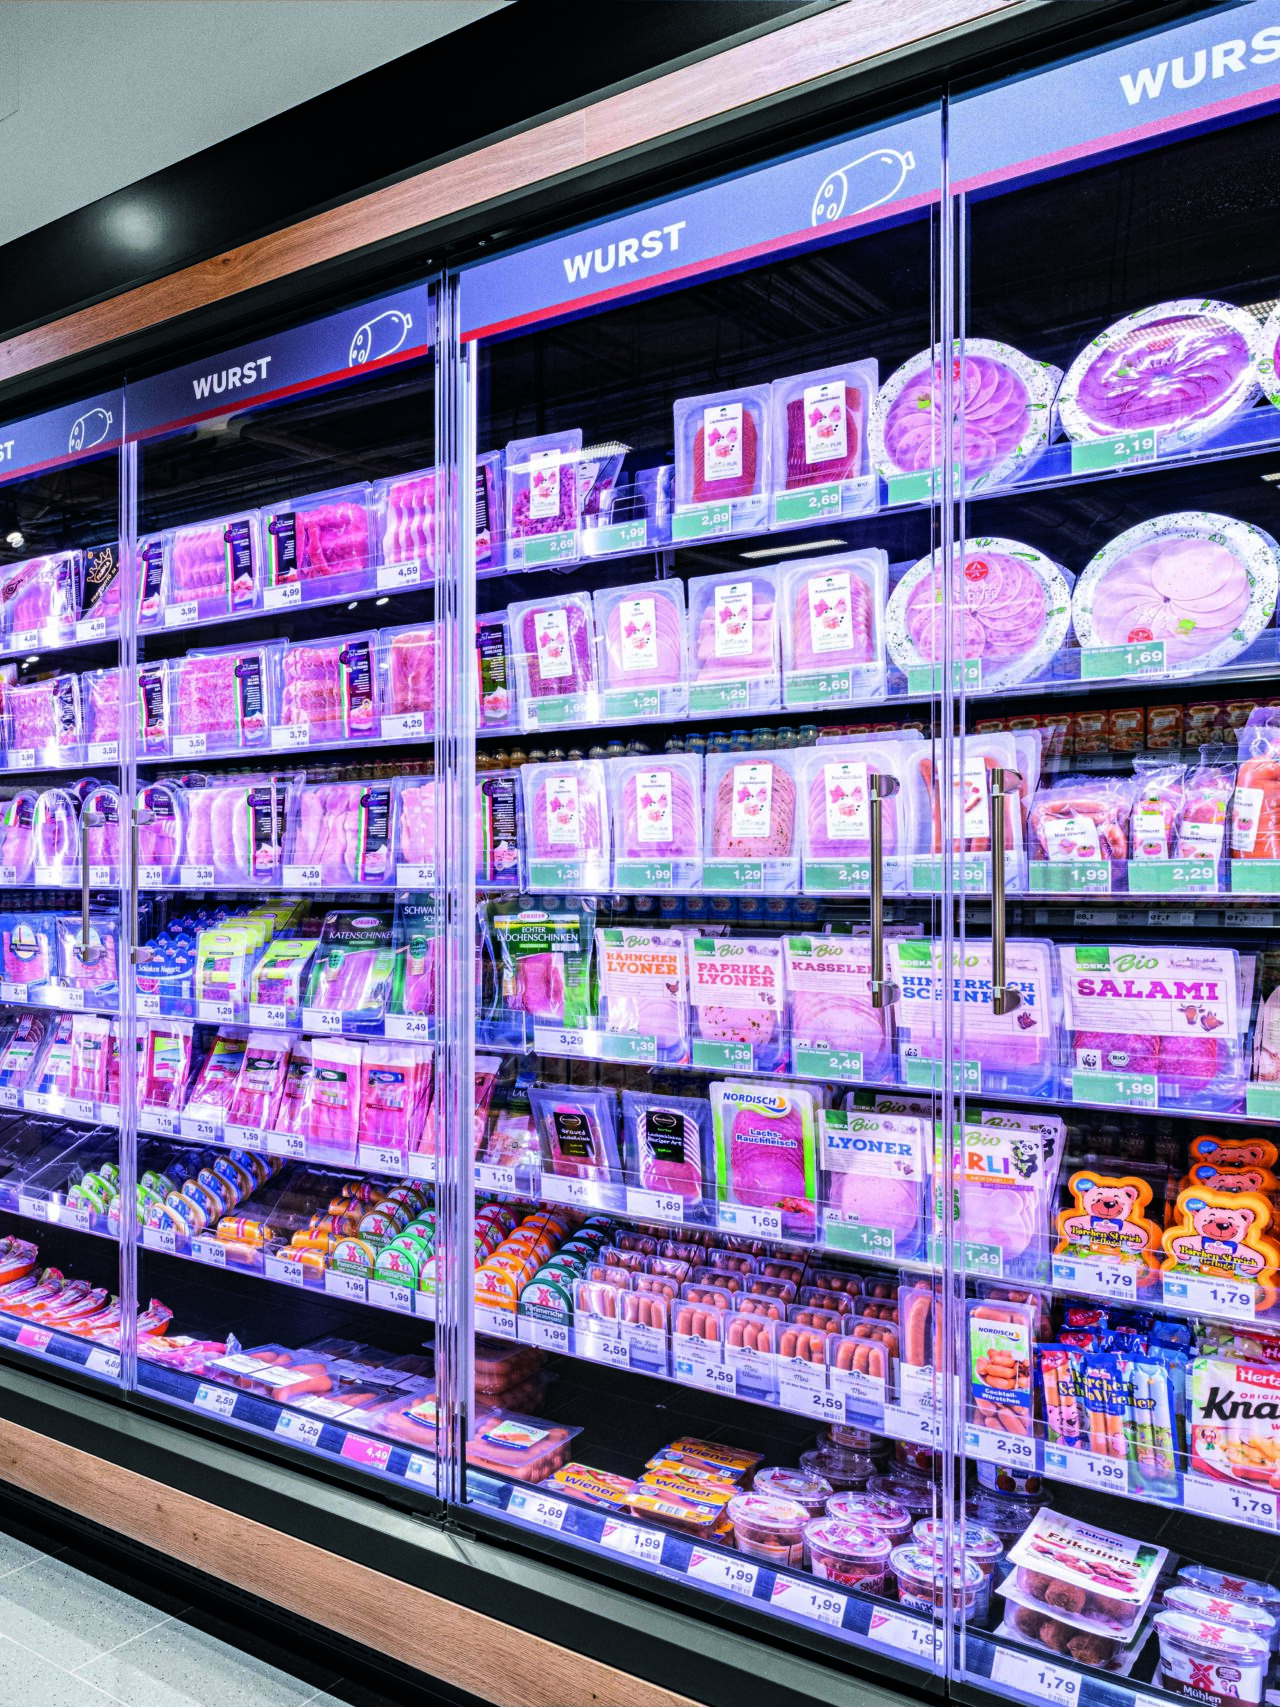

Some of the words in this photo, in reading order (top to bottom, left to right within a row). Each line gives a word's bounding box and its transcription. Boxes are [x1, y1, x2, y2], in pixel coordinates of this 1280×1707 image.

[1119, 26, 1280, 106] WURS
[563, 222, 687, 283] WURST
[192, 356, 273, 400] WURST
[1114, 438, 1153, 455] 2,19
[809, 494, 839, 508] 2,69
[702, 512, 729, 526] 2,89
[620, 526, 644, 539] 1,99
[550, 539, 574, 551] 2,69
[398, 565, 418, 577] 4,59
[282, 588, 299, 598] 4,99
[180, 606, 197, 617] 3,99
[90, 622, 105, 631] 4,99
[1124, 651, 1163, 665] 1,69
[819, 680, 849, 692] 2,69
[719, 689, 746, 701] 1,29
[633, 697, 657, 708] 1,29
[402, 719, 422, 730] 4,29
[289, 729, 307, 740] 3,79
[189, 739, 205, 748] 3,59
[146, 871, 161, 880] 2,19
[197, 870, 213, 879] 3,39
[301, 870, 320, 880] 4,59
[556, 869, 580, 880] 1,29
[645, 869, 670, 880] 1,99
[734, 870, 761, 881] 1,29
[839, 870, 870, 881] 2,49
[1072, 869, 1108, 882] 1,99
[1172, 868, 1213, 881] 2,29
[521, 926, 546, 934] ECHTER
[625, 935, 650, 948] Bio
[606, 951, 677, 963] HÄHNCHEN
[717, 944, 744, 957] Bio
[813, 944, 843, 957] Bio
[137, 964, 160, 973] Schinken
[608, 962, 678, 975] LYONER
[697, 962, 775, 976] PAPRIKA
[899, 959, 932, 967] EDEKA
[1076, 962, 1111, 970] EDEKA
[1113, 953, 1159, 972] Bio
[697, 973, 775, 987] LYONER
[902, 976, 1035, 993] HINERKCH
[1077, 978, 1219, 1001] SALAMI
[144, 1000, 159, 1009] 2,39
[216, 1007, 233, 1016] 1,29
[267, 1010, 285, 1020] 2,49
[322, 1015, 340, 1024] 2,19
[406, 1022, 427, 1032] 2,49
[560, 1035, 584, 1046] 3,29
[629, 1041, 655, 1051] 1,39
[724, 1049, 751, 1060] 1,39
[829, 1058, 860, 1070] 2,49
[1115, 1081, 1154, 1095] 1,99
[723, 1092, 777, 1106] NORDISCH
[877, 1100, 907, 1114] Bio
[157, 1117, 172, 1127] 1,19
[849, 1117, 880, 1132] Bio
[197, 1124, 213, 1134] 2,19
[749, 1128, 782, 1139] Lachs-
[242, 1131, 259, 1142] 1,59
[736, 1134, 797, 1148] Rauchfleisch
[965, 1131, 1001, 1146] Bio
[286, 1139, 303, 1149] 1,59
[827, 1134, 912, 1157] LYONER
[380, 1153, 400, 1165] 2,19
[491, 1172, 513, 1183] 1,19
[655, 1199, 681, 1211] 1,69
[1188, 1201, 1205, 1210] Neu!
[751, 1215, 779, 1228] 1,69
[159, 1235, 174, 1245] 1,99
[861, 1233, 892, 1247] 1,39
[208, 1248, 225, 1258] 1,09
[965, 1250, 999, 1264] 1,49
[283, 1266, 302, 1277] 2,49
[1095, 1271, 1133, 1287] 1,79
[346, 1281, 364, 1292] 1,99
[389, 1291, 409, 1303] 1,99
[1210, 1289, 1251, 1306] 1,79
[492, 1316, 514, 1328] 1,99
[543, 1328, 566, 1341] 1,99
[978, 1326, 1014, 1337] NORDISCH
[602, 1343, 627, 1357] 2,59
[706, 1368, 733, 1383] 2,59
[981, 1393, 1021, 1405] Würstchen
[984, 1387, 1018, 1398] Cocktail-
[215, 1394, 234, 1407] 2,59
[812, 1395, 843, 1410] 2,59
[1200, 1387, 1280, 1421] Kna
[298, 1423, 319, 1437] 3,29
[366, 1445, 388, 1461] 4,49
[681, 1444, 736, 1464] Wiener
[997, 1439, 1032, 1457] 2,39
[1087, 1461, 1124, 1479] 1,99
[565, 1475, 618, 1497] Wiener
[655, 1477, 711, 1498] Wiener
[536, 1502, 563, 1519] 2,69
[1231, 1496, 1273, 1516] 1,79
[633, 1533, 661, 1549] 1,99
[1076, 1528, 1123, 1548] Abbelen
[1047, 1531, 1142, 1569] Frikolinos
[723, 1565, 754, 1584] 1,99
[809, 1594, 842, 1614] 1,99
[911, 1628, 943, 1650] 1,99
[1037, 1671, 1076, 1694] 1,79
[1183, 1684, 1222, 1705] Mühlen
